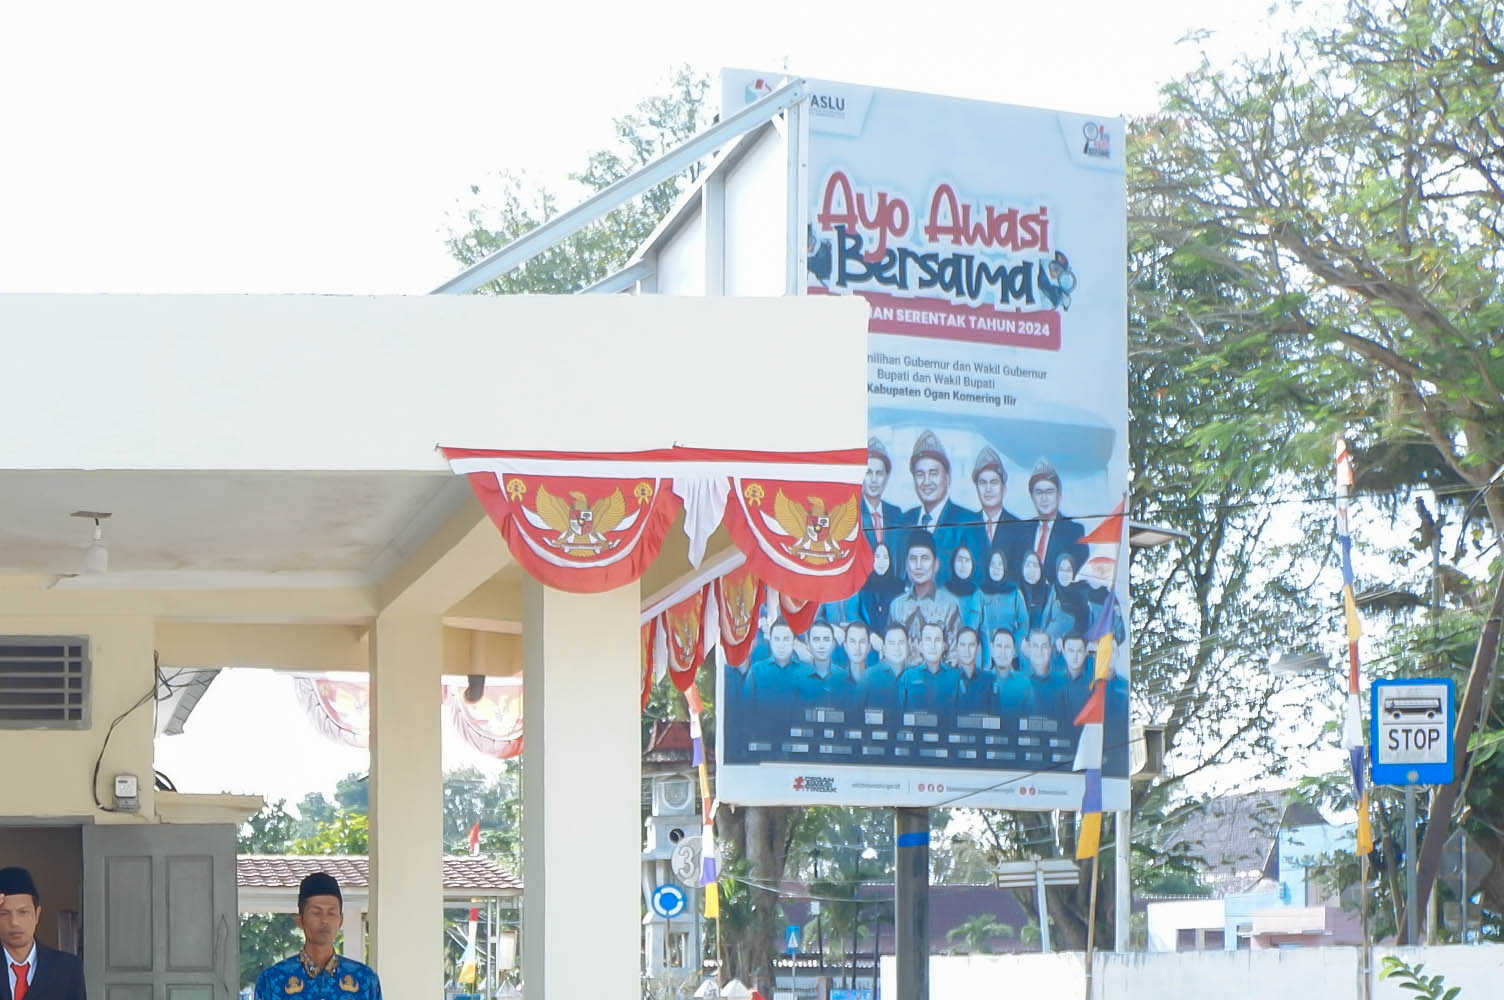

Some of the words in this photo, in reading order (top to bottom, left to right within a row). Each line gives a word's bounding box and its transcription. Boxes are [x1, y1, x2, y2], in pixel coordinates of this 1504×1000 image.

[810, 94, 846, 112] ASLU
[817, 170, 910, 263] Ayo
[924, 183, 1050, 252] Awasi
[834, 224, 1036, 305] Bersama
[896, 308, 966, 328] SERENTAK
[968, 316, 1016, 333] TAHUN
[1018, 320, 1050, 337] 2024
[877, 368, 910, 383] Bupati
[913, 371, 931, 383] dan
[934, 373, 961, 386] Wakil
[963, 376, 995, 390] Bupati
[904, 356, 950, 370] Gubernur
[953, 360, 971, 372] dan
[974, 361, 1000, 375] Wakil
[1003, 364, 1048, 380] Gubernur
[867, 383, 921, 398] Kabupaten
[924, 387, 950, 402] Ogan
[952, 390, 1001, 407] Komering
[1003, 393, 1017, 406] Ilir
[1388, 728, 1440, 751] STOP
